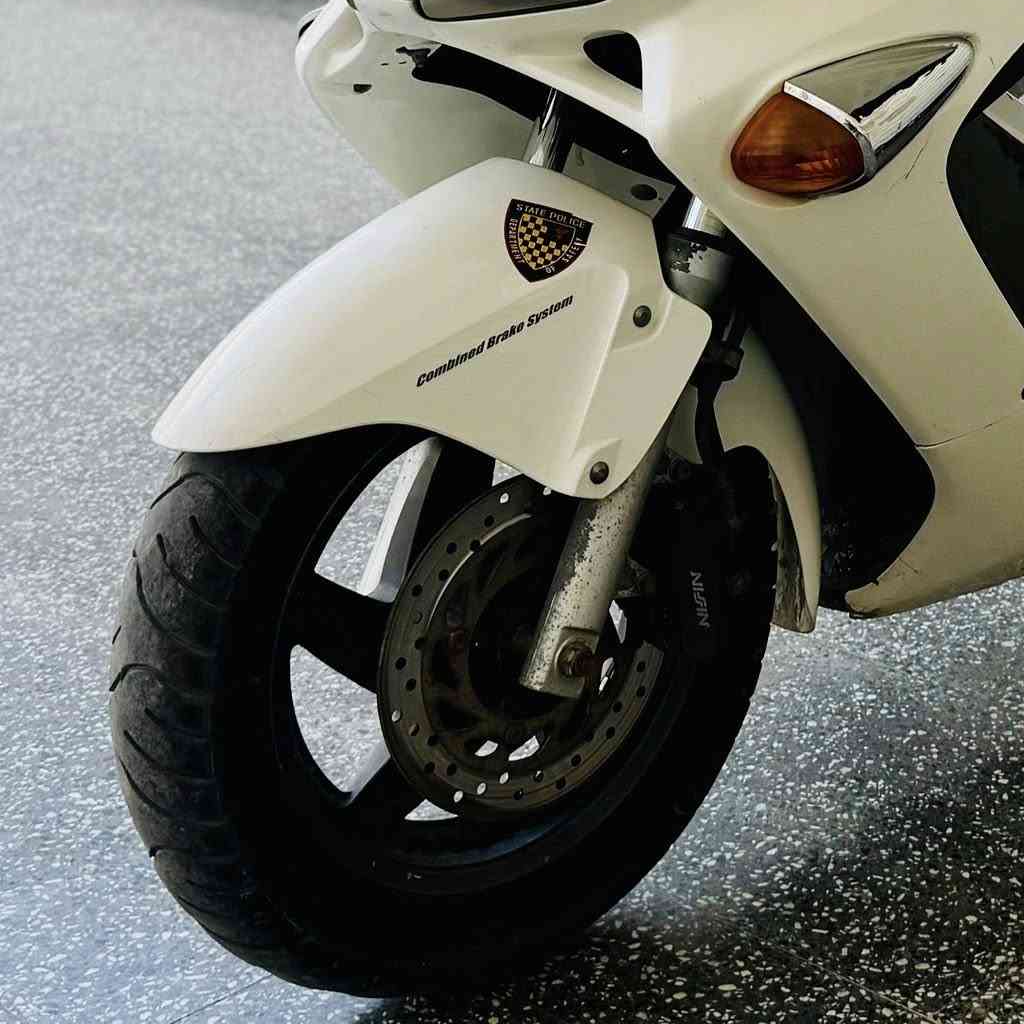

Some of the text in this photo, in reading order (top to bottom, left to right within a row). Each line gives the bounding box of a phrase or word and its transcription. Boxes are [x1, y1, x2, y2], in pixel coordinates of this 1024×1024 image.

[508, 218, 525, 264] DEPARTMENT
[516, 203, 586, 229] STATE POLICE
[416, 295, 574, 388] Combined Brake System
[690, 571, 711, 628] NISSIN
